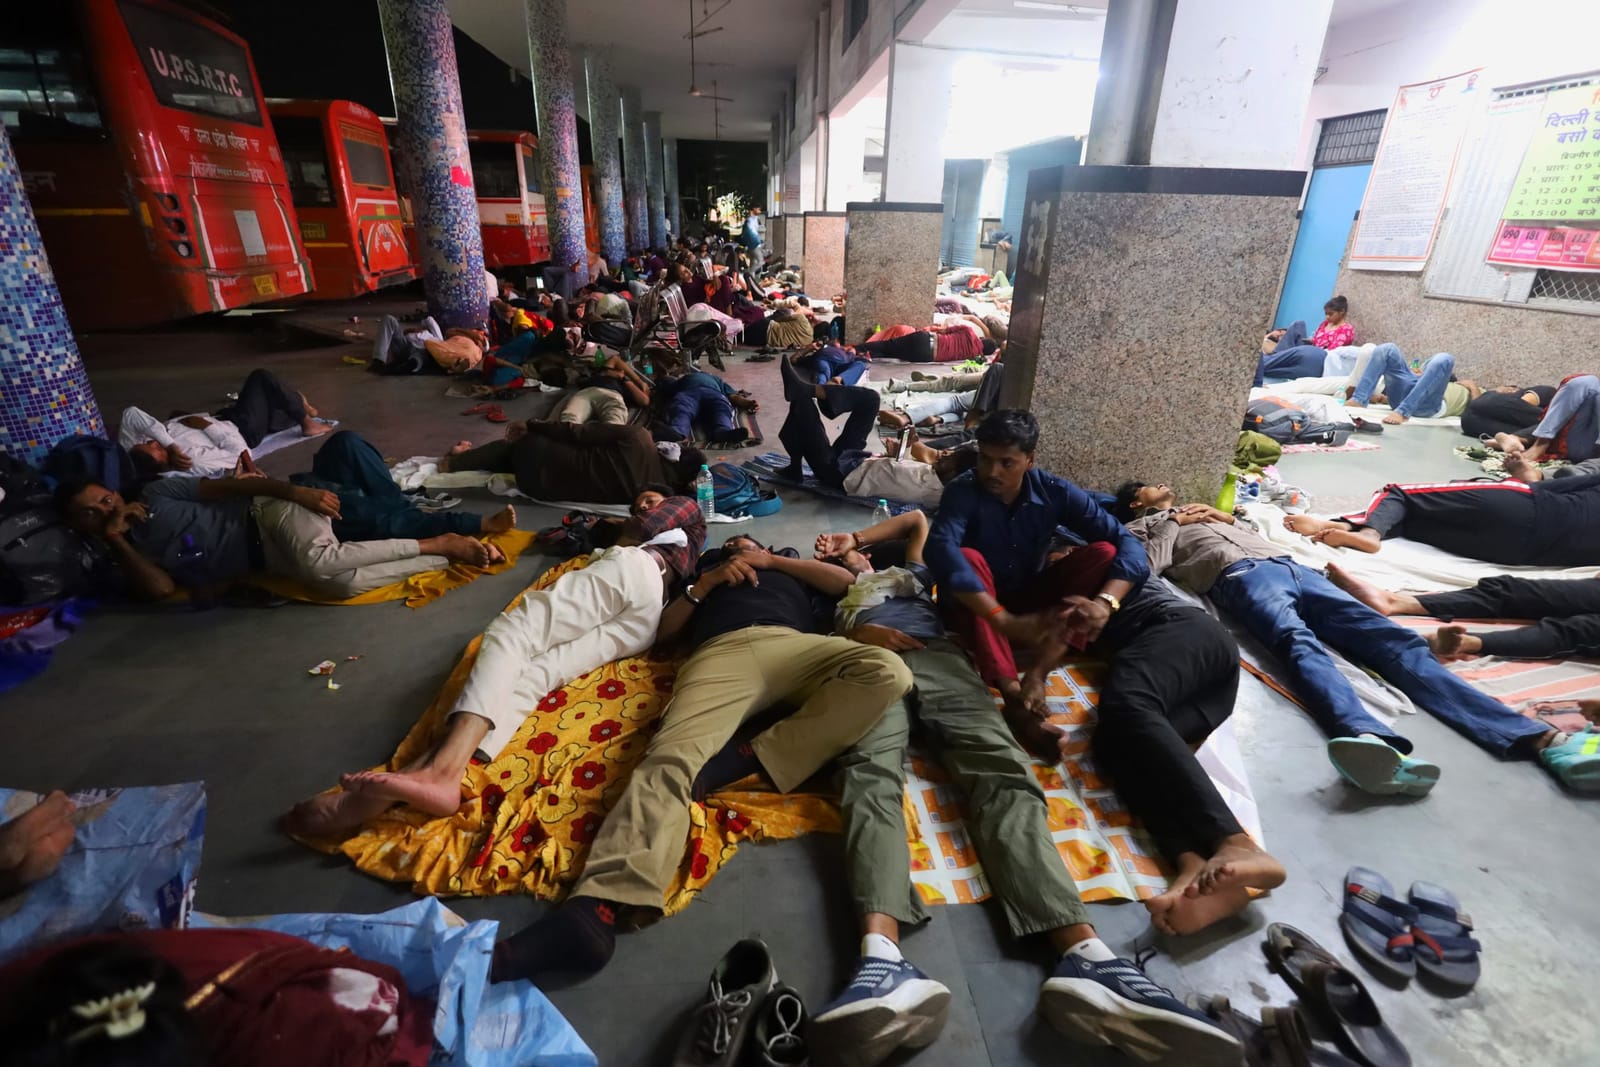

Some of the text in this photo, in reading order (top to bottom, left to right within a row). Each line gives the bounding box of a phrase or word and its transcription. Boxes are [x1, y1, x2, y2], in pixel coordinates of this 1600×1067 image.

[149, 47, 242, 97] U.P.S.R.T.C
[1545, 108, 1590, 128] दिल्ली
[1574, 162, 1592, 170] 09
[1577, 207, 1597, 216] बजे
[1525, 230, 1540, 241] 181
